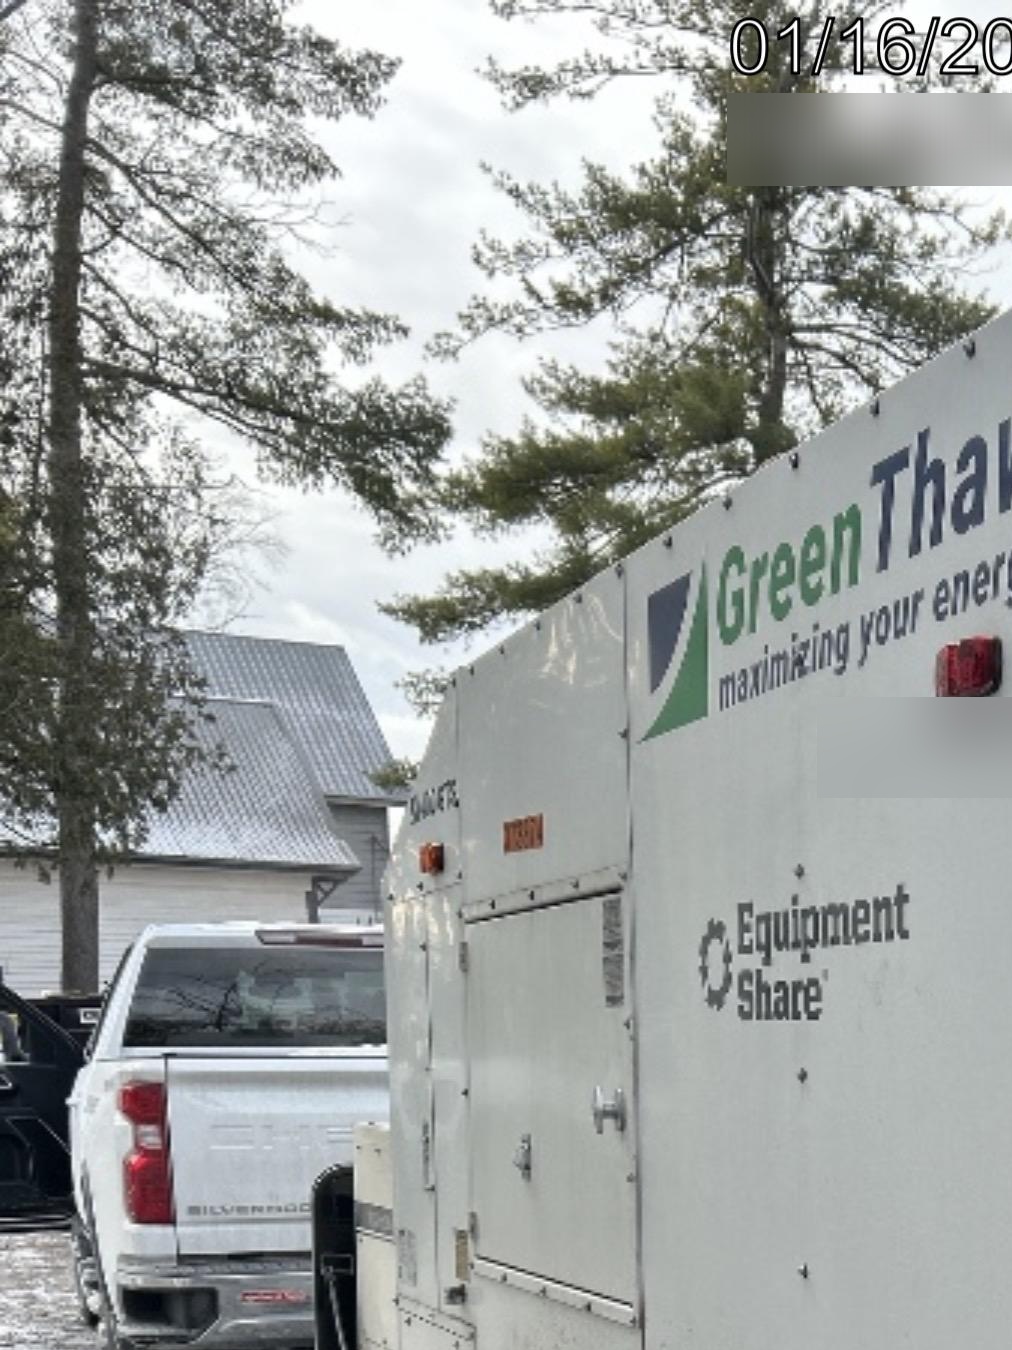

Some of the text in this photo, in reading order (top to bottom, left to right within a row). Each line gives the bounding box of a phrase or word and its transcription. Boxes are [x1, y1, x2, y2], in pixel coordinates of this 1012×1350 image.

[718, 620, 850, 711] maximizing
[858, 588, 925, 667] your
[737, 883, 910, 967] Equipment
[737, 968, 823, 1021] Share
